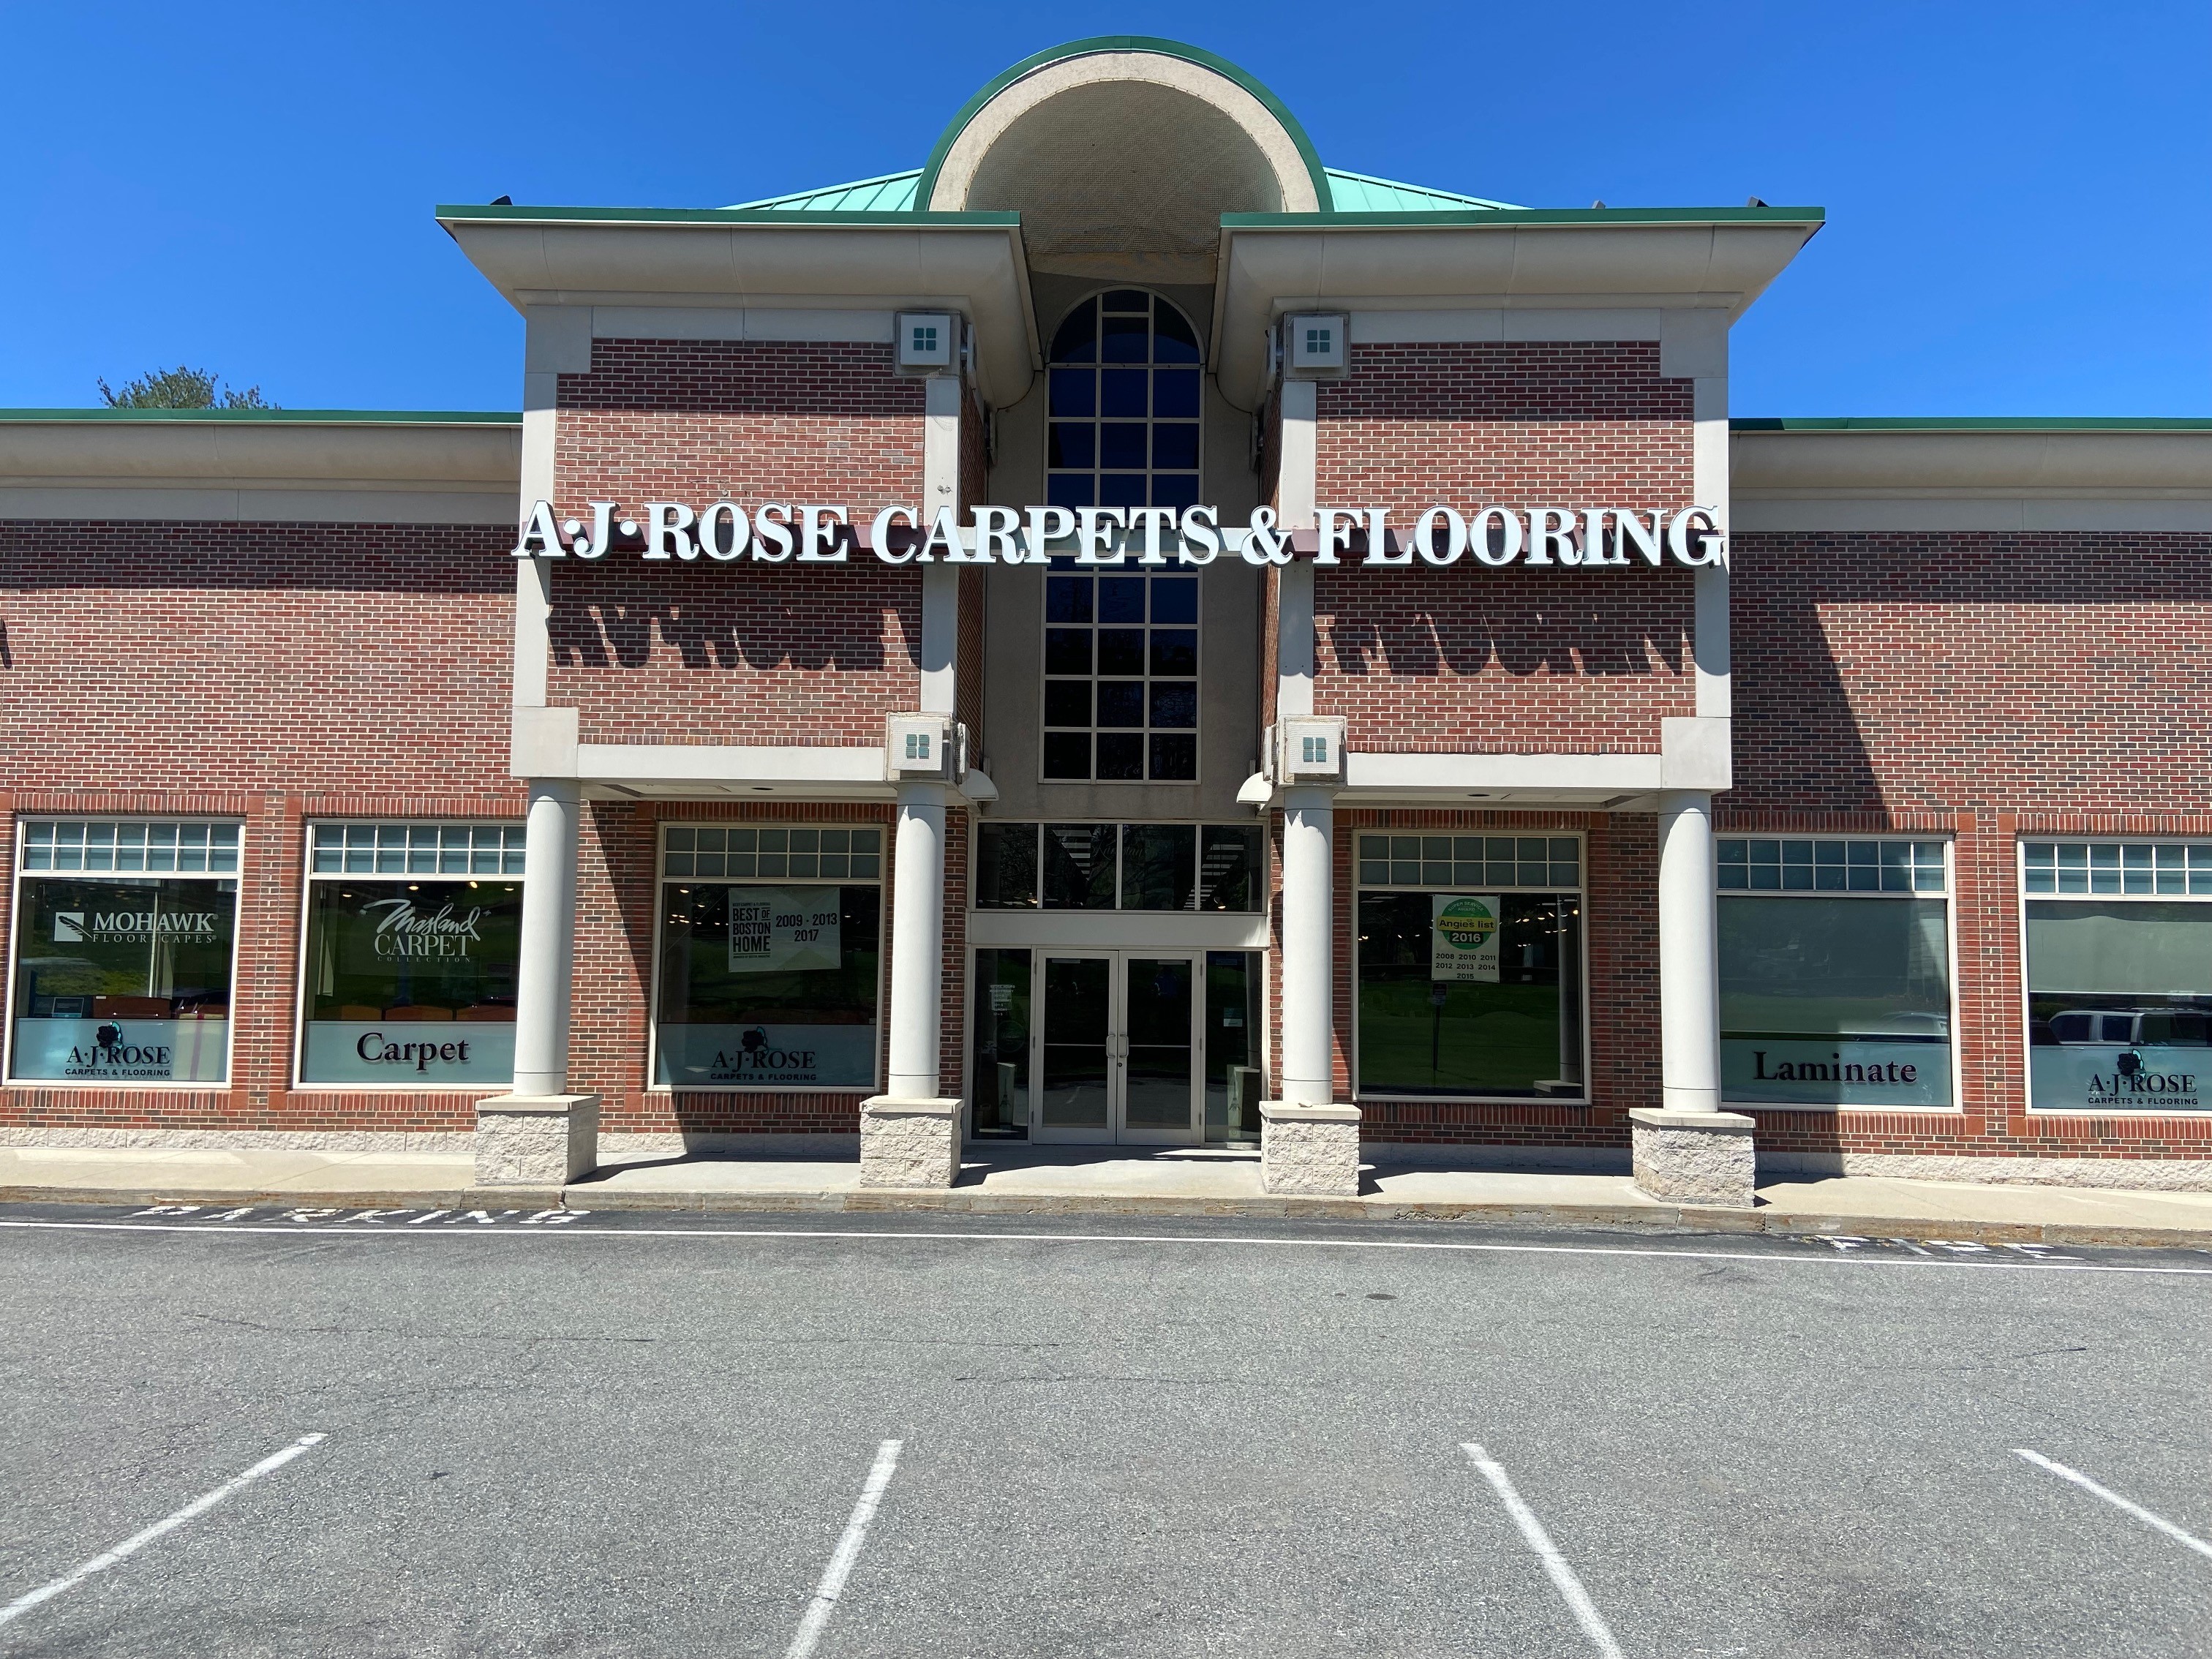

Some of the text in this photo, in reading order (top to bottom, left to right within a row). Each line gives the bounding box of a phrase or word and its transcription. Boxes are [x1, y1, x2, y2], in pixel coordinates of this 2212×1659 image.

[877, 504, 1219, 566] CARPETS
[1240, 505, 1294, 568] &
[1312, 505, 1727, 570] FLOORING
[1448, 900, 1484, 911] SUPER SERVICE
[358, 898, 481, 941] Masland
[732, 908, 770, 922] BEST OF
[775, 913, 838, 928] 2009 2013
[732, 922, 770, 936] BOSTON
[1478, 920, 1494, 928] list
[92, 934, 212, 944] FLOORCAPES
[794, 929, 819, 942] 2017
[1452, 933, 1481, 943] 2016
[375, 933, 474, 956] CARPET
[733, 936, 770, 952] HOME
[356, 1032, 469, 1072] Carpet
[1755, 1051, 1918, 1083] Laminate
